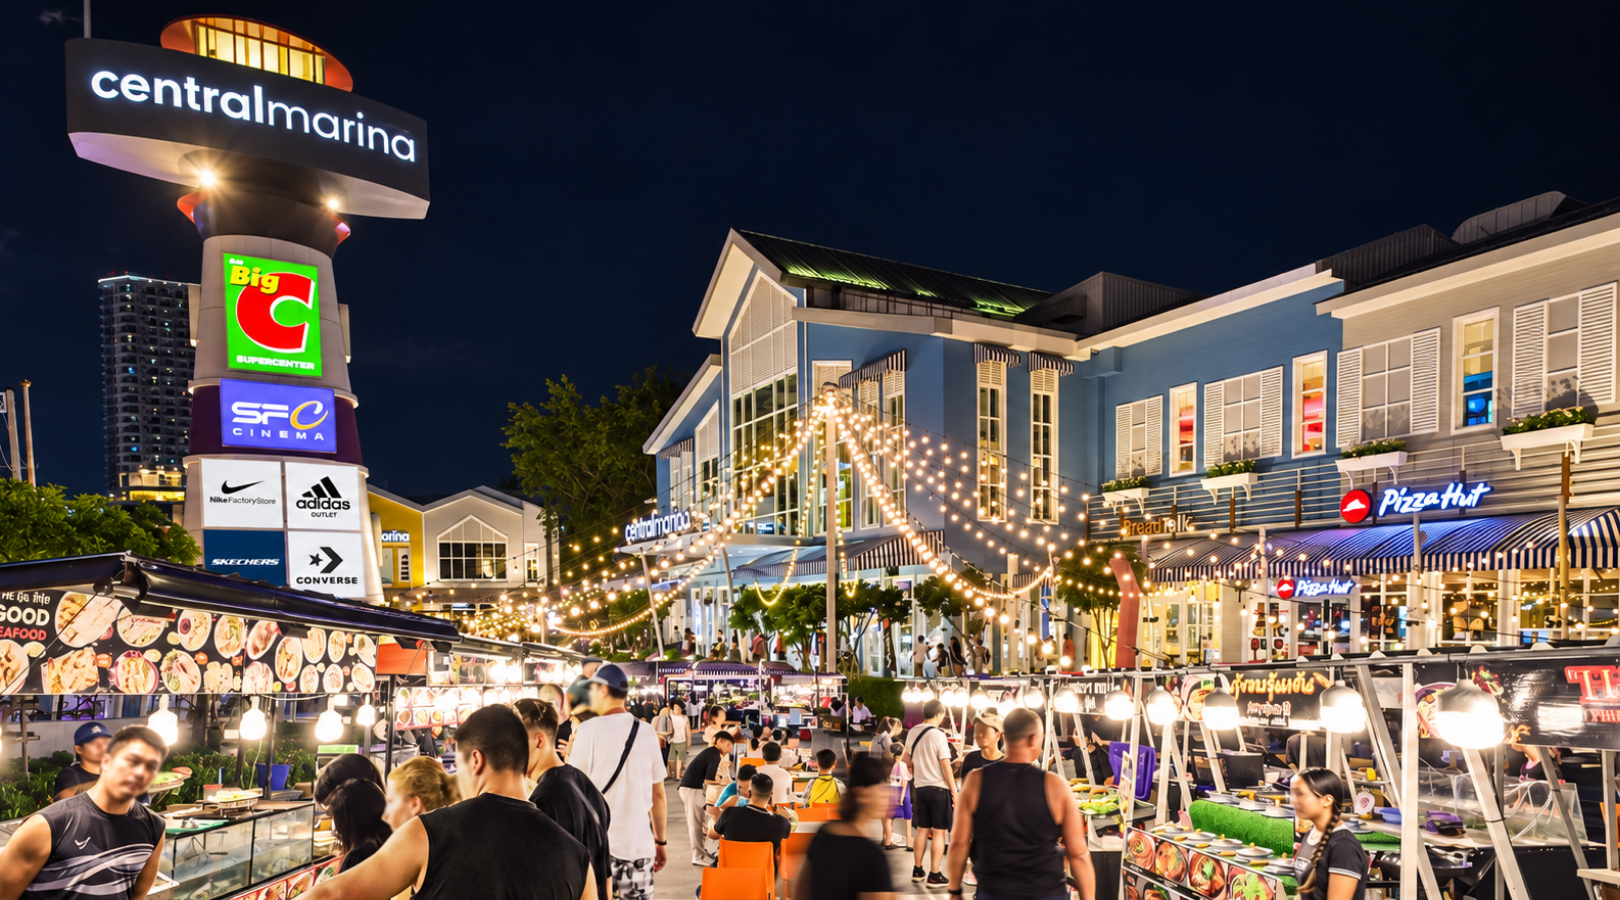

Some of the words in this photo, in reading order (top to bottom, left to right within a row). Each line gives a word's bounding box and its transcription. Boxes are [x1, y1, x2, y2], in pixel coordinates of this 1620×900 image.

[91, 70, 416, 163] centralmarina
[230, 265, 280, 295] Big
[236, 272, 315, 353] C
[236, 355, 315, 370] SUPERCENTER
[232, 428, 324, 441] CINEMA
[296, 497, 350, 511] adidas
[1379, 487, 1439, 517] Pizza
[1441, 482, 1491, 510] Hut
[211, 558, 280, 566] SKECHERS
[296, 576, 358, 585] CONVERSE
[1295, 579, 1328, 597] Pizza
[1328, 578, 1354, 595] Hut
